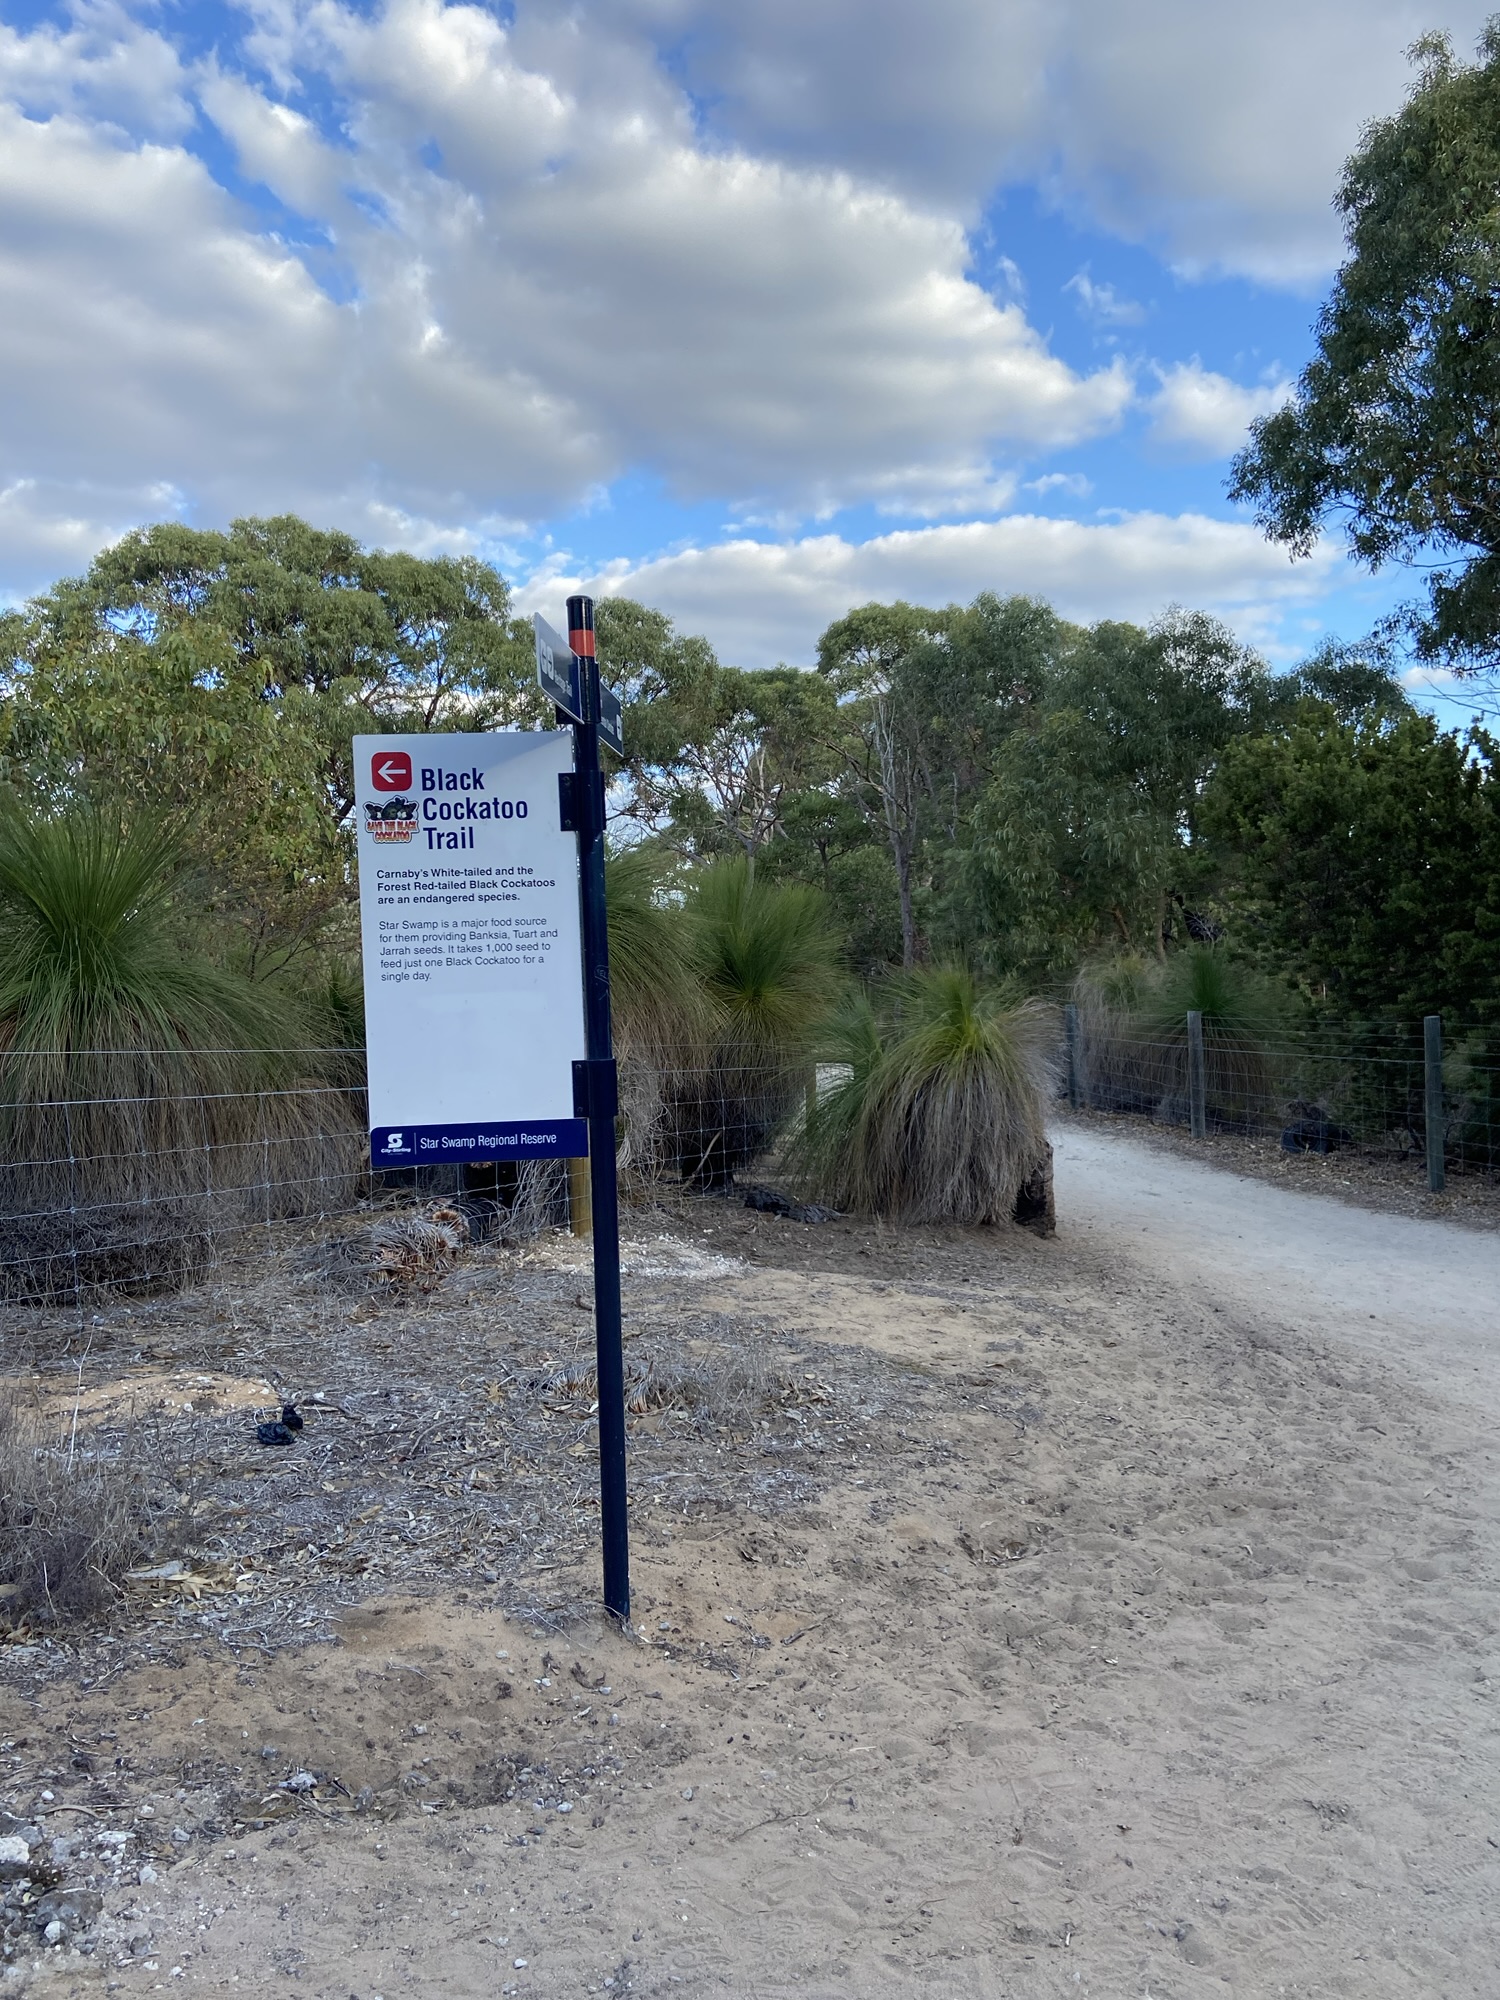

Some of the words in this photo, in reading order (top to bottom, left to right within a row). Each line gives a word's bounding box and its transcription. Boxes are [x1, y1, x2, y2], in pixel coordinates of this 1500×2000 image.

[421, 767, 485, 791] Black
[422, 797, 528, 821] Cockatoo
[384, 821, 395, 831] THE
[423, 826, 474, 850] Trail
[376, 868, 429, 880] Carnaby's
[431, 867, 492, 877] White-tailed
[495, 866, 514, 876] and
[517, 866, 533, 875] the
[377, 882, 411, 891] Forest
[414, 881, 466, 890] Red-tailed
[469, 880, 498, 889] Black
[501, 879, 555, 888] Cockatoos
[377, 896, 394, 904] are
[413, 893, 475, 904] endangered
[478, 892, 520, 903] species.
[379, 920, 399, 930] Star
[402, 920, 438, 930] Swamp
[441, 920, 449, 928] is
[452, 920, 458, 928] a
[461, 918, 488, 929] major
[491, 917, 512, 926] food
[514, 918, 547, 926] source
[379, 934, 392, 943] for
[395, 934, 419, 942] them
[422, 932, 466, 943] providing
[469, 931, 511, 940] Banksia,
[512, 930, 537, 938] Tuart
[540, 929, 558, 938] and
[380, 946, 411, 955] Jarrah
[413, 945, 445, 954] seeds.
[448, 945, 454, 953] It
[457, 944, 483, 953] takes
[486, 943, 513, 953] 1,000
[515, 942, 539, 951] seed
[541, 942, 551, 950] to
[380, 959, 401, 968] feed
[404, 959, 422, 969] just
[424, 959, 443, 967] one
[446, 957, 472, 966] Black
[475, 956, 520, 965] Cockatoo
[523, 955, 535, 964] for
[381, 972, 410, 983] single
[412, 971, 432, 982] day.
[420, 1137, 439, 1149] Star
[441, 1136, 475, 1150] Swamp
[478, 1134, 518, 1148] Regional
[520, 1133, 557, 1145] Reserve
